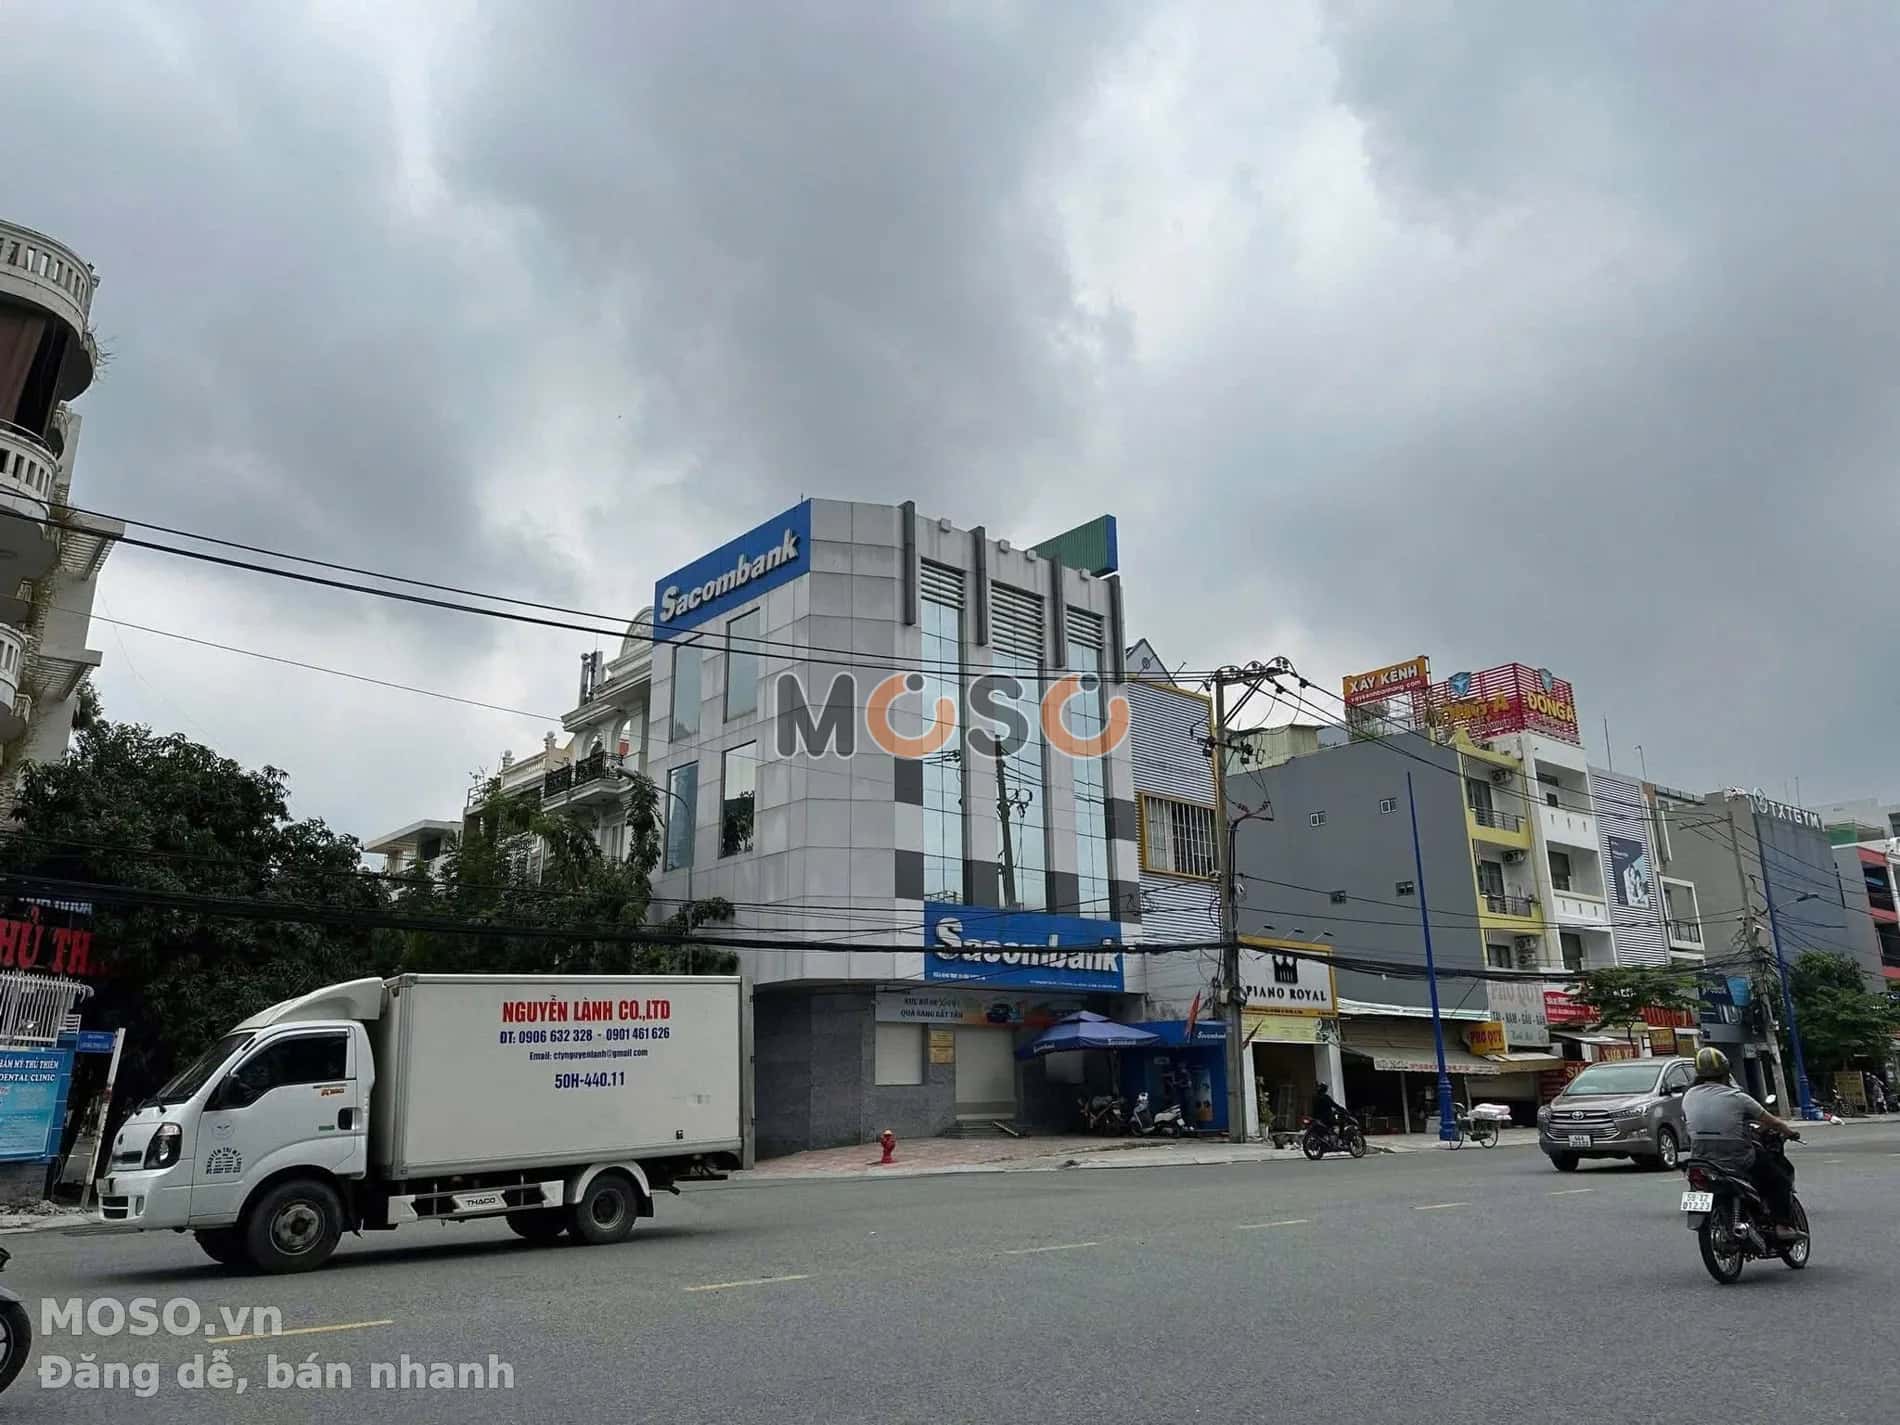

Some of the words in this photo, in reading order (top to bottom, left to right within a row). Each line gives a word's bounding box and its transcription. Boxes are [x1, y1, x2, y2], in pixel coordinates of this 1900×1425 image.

[660, 528, 800, 622] Sacombank
[934, 917, 1119, 972] Sacombank
[1246, 986, 1285, 999] PIANO
[1289, 988, 1327, 1002] ROYAL
[502, 994, 568, 1023] NGUYỄN
[573, 997, 613, 1022] LÀNH
[618, 1000, 671, 1022] CO.,LTD
[518, 1030, 547, 1044] 0906
[550, 1029, 570, 1043] 632
[573, 1029, 593, 1042] 328
[606, 1028, 630, 1041] 0901
[632, 1027, 649, 1041] 461
[651, 1026, 670, 1040] 626
[529, 1051, 552, 1062] Email:
[30, 1073, 55, 1082] CLINIC
[554, 1071, 625, 1089] 50H-440.11
[465, 1197, 496, 1208] THACO
